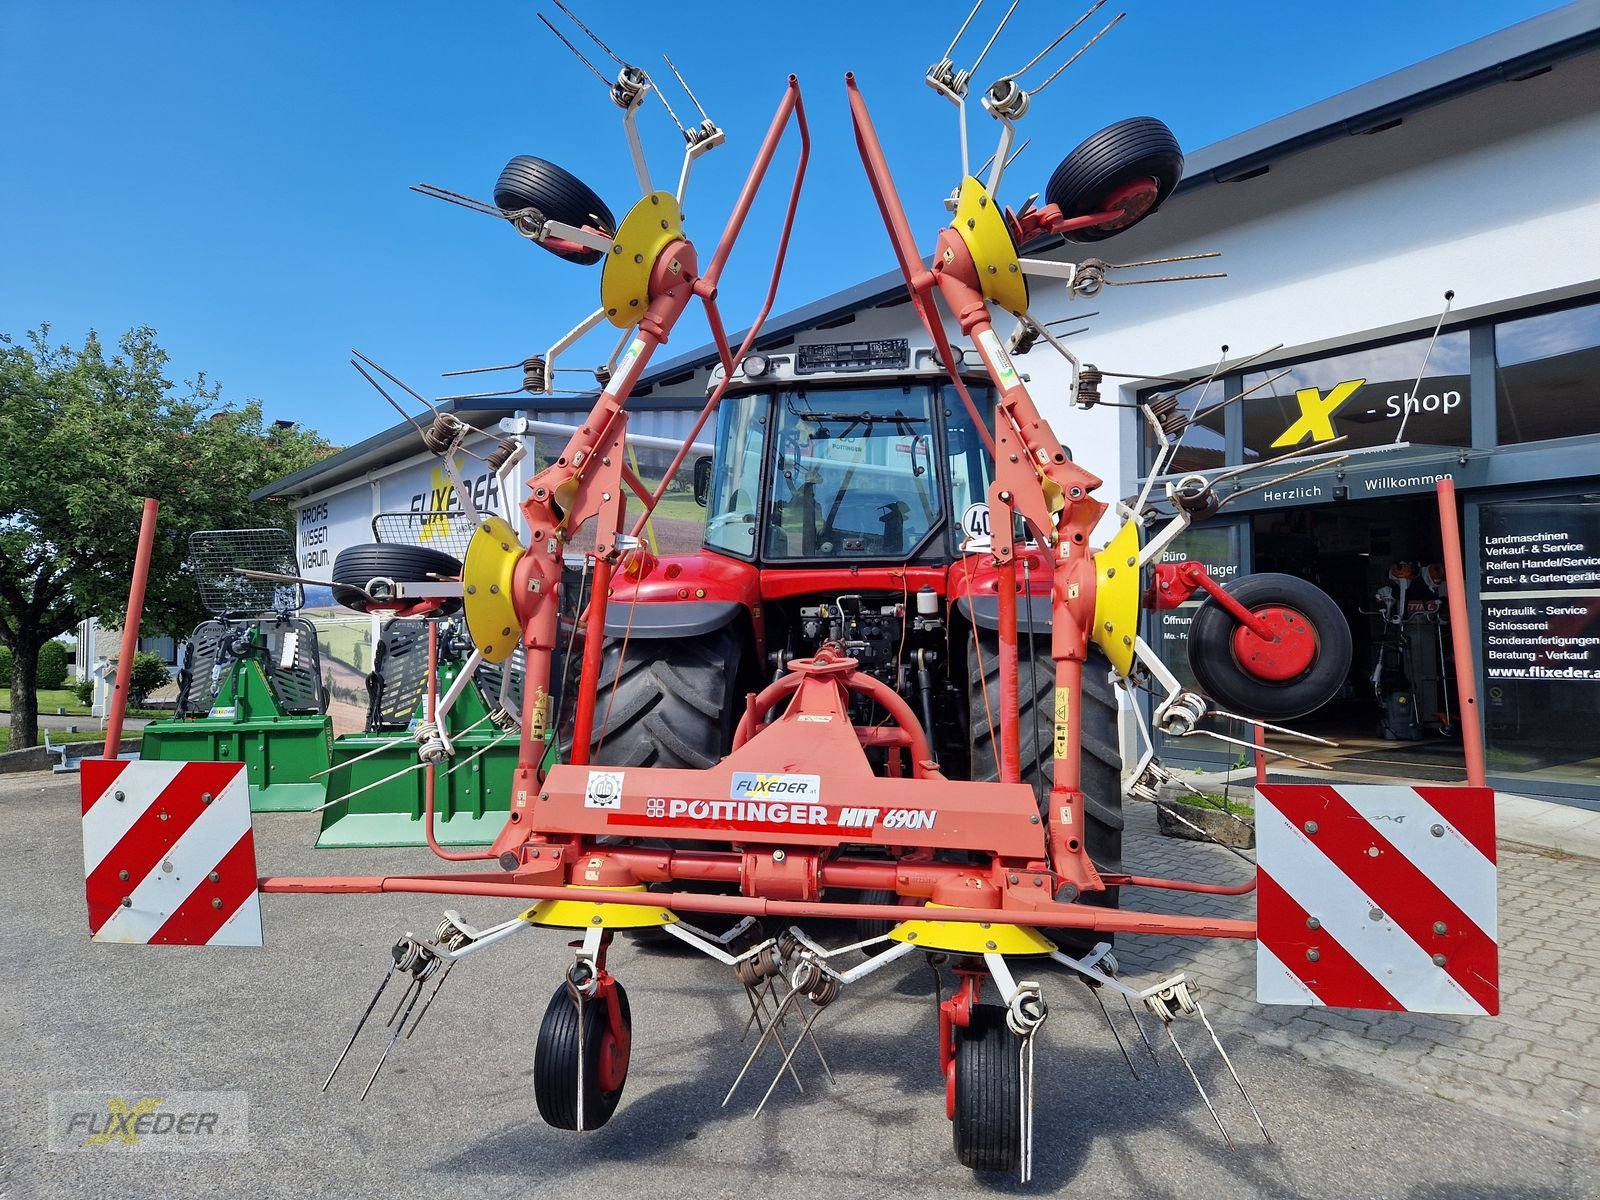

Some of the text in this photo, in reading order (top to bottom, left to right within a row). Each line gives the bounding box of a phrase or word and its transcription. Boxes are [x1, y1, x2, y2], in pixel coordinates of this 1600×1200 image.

[1270, 378, 1366, 448] X
[1386, 391, 1461, 418] Shop
[1364, 473, 1453, 490] Willkommen
[1263, 485, 1322, 502] Herzlich
[971, 511, 990, 535] 40
[1485, 532, 1568, 545] Landmaschinen
[1485, 542, 1584, 556] Verkauf- & Service
[1163, 551, 1187, 562] Büro
[1486, 561, 1519, 571] Reifen
[1486, 575, 1515, 585] Forst-
[1519, 574, 1528, 584] &
[1487, 606, 1537, 618] Hydraulik
[1546, 605, 1588, 616] Service
[1163, 614, 1192, 625] Öffnun
[1488, 621, 1549, 631] Schlosserei
[1488, 635, 1600, 647] Sonderanfertigungen
[1488, 650, 1536, 662] Beratung
[1545, 650, 1590, 660] Verkauf
[1487, 666, 1600, 679] www.flixeder.a
[736, 780, 809, 794] FLIXEDER
[668, 799, 938, 830] PÖTTINGER HIT 690N
